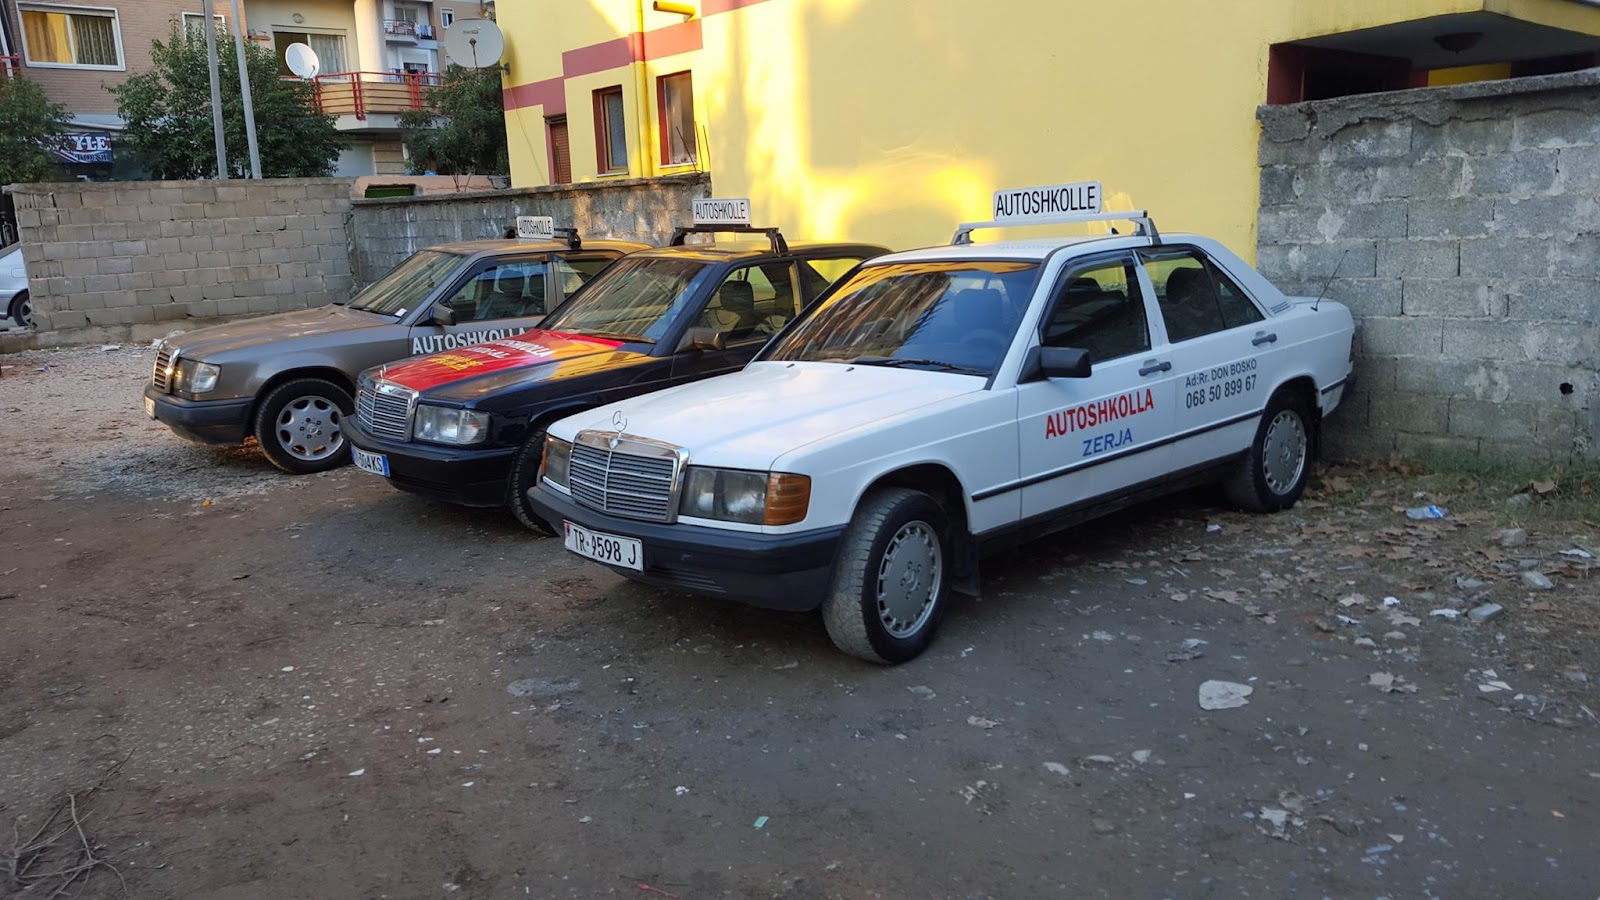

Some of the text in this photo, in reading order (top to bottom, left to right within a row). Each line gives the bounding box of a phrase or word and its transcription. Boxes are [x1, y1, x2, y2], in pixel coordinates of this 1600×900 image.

[695, 202, 746, 220] AUTOSHKOLLE
[996, 185, 1096, 217] AUTOSHKOLLE
[1211, 365, 1229, 381] DON
[1230, 358, 1257, 376] BOSKO
[1186, 374, 1257, 409] 068 50 899 67
[1045, 388, 1154, 439] AUTOSHKOLLA
[1082, 428, 1133, 457] ZERJA
[628, 543, 637, 565] J
